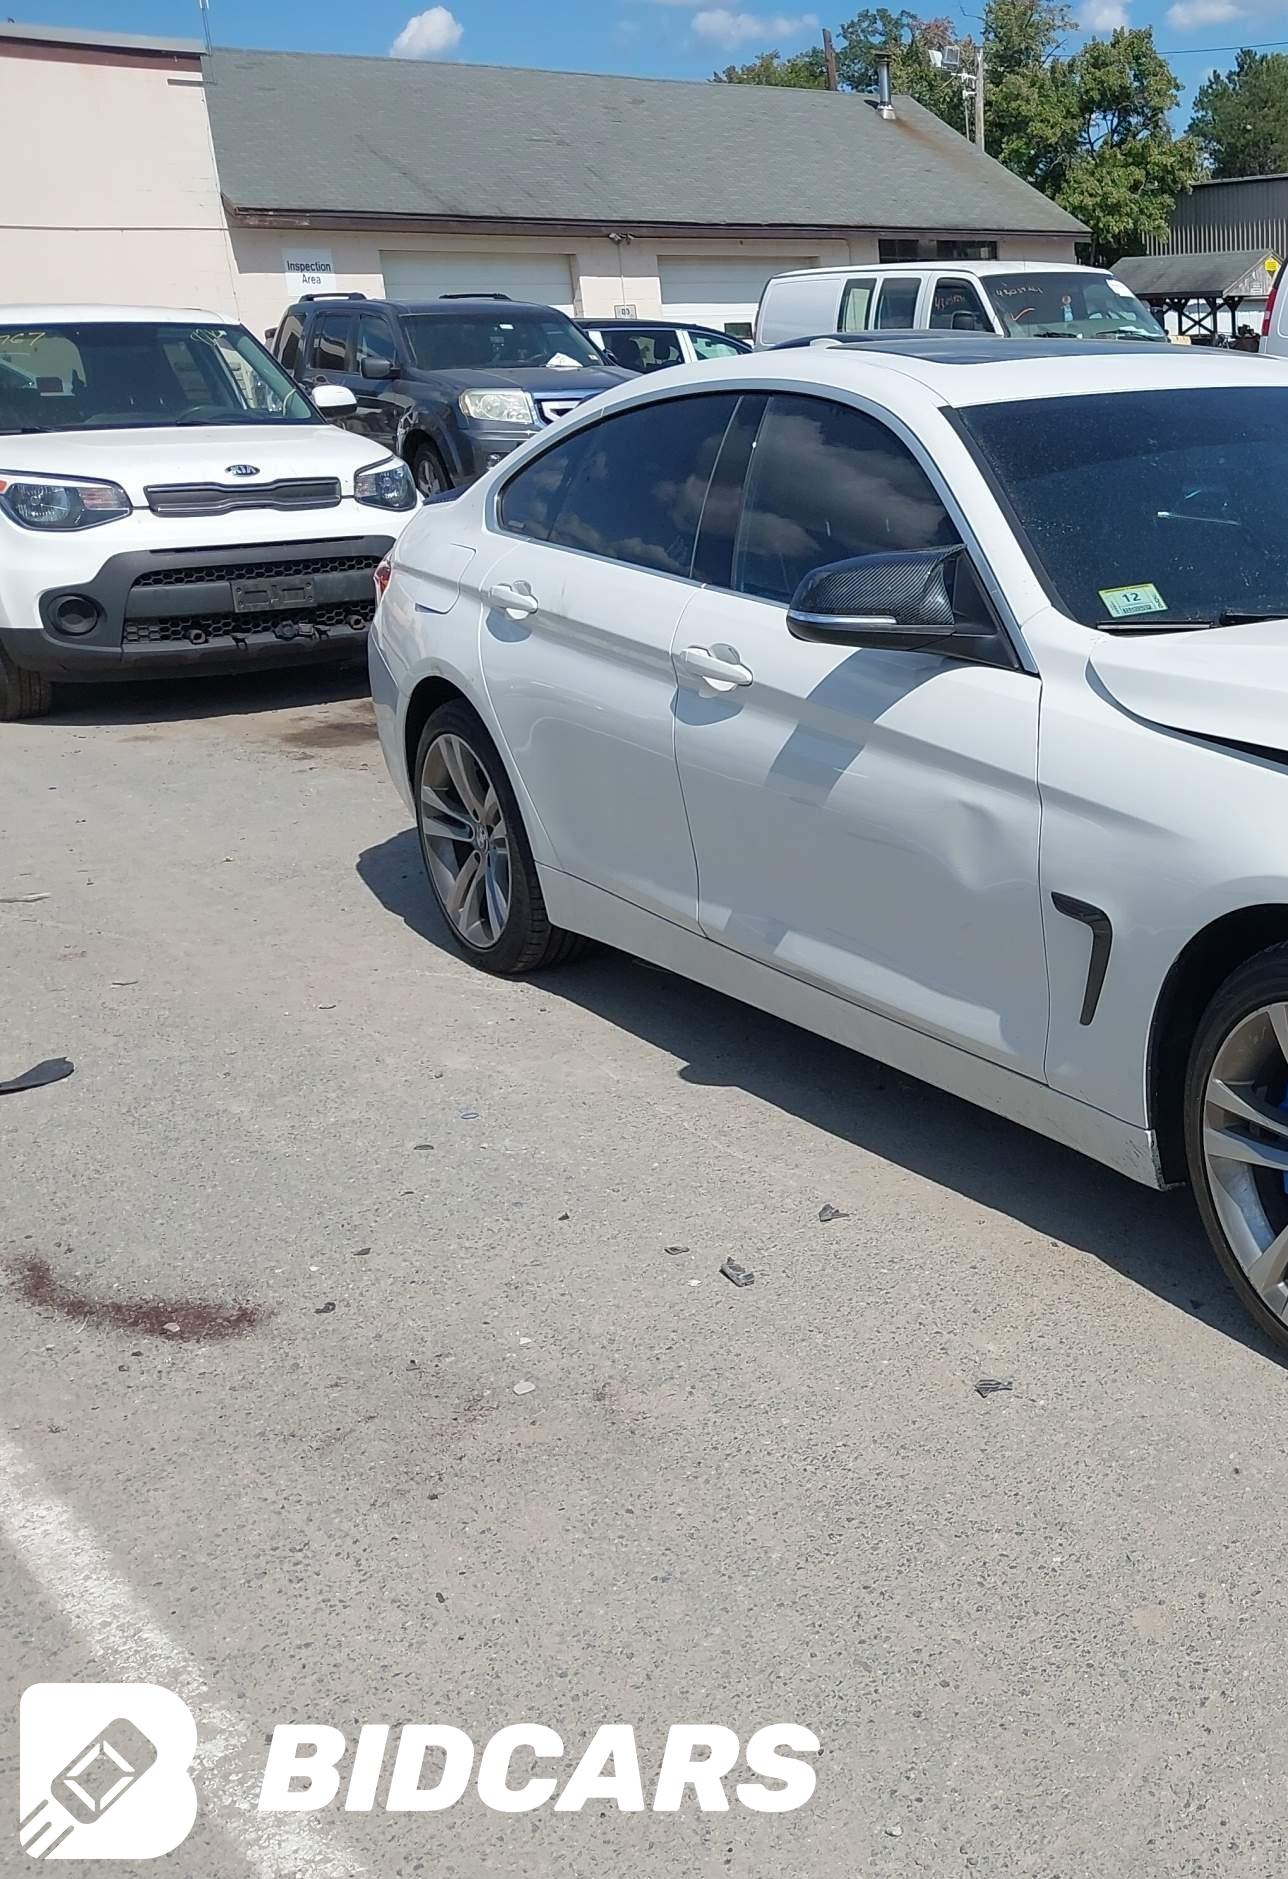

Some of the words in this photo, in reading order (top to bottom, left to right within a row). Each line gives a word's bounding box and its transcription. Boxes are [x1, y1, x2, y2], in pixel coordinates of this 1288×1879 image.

[286, 260, 332, 273] Inspection
[302, 273, 322, 285] Area
[1122, 592, 1142, 603] 12
